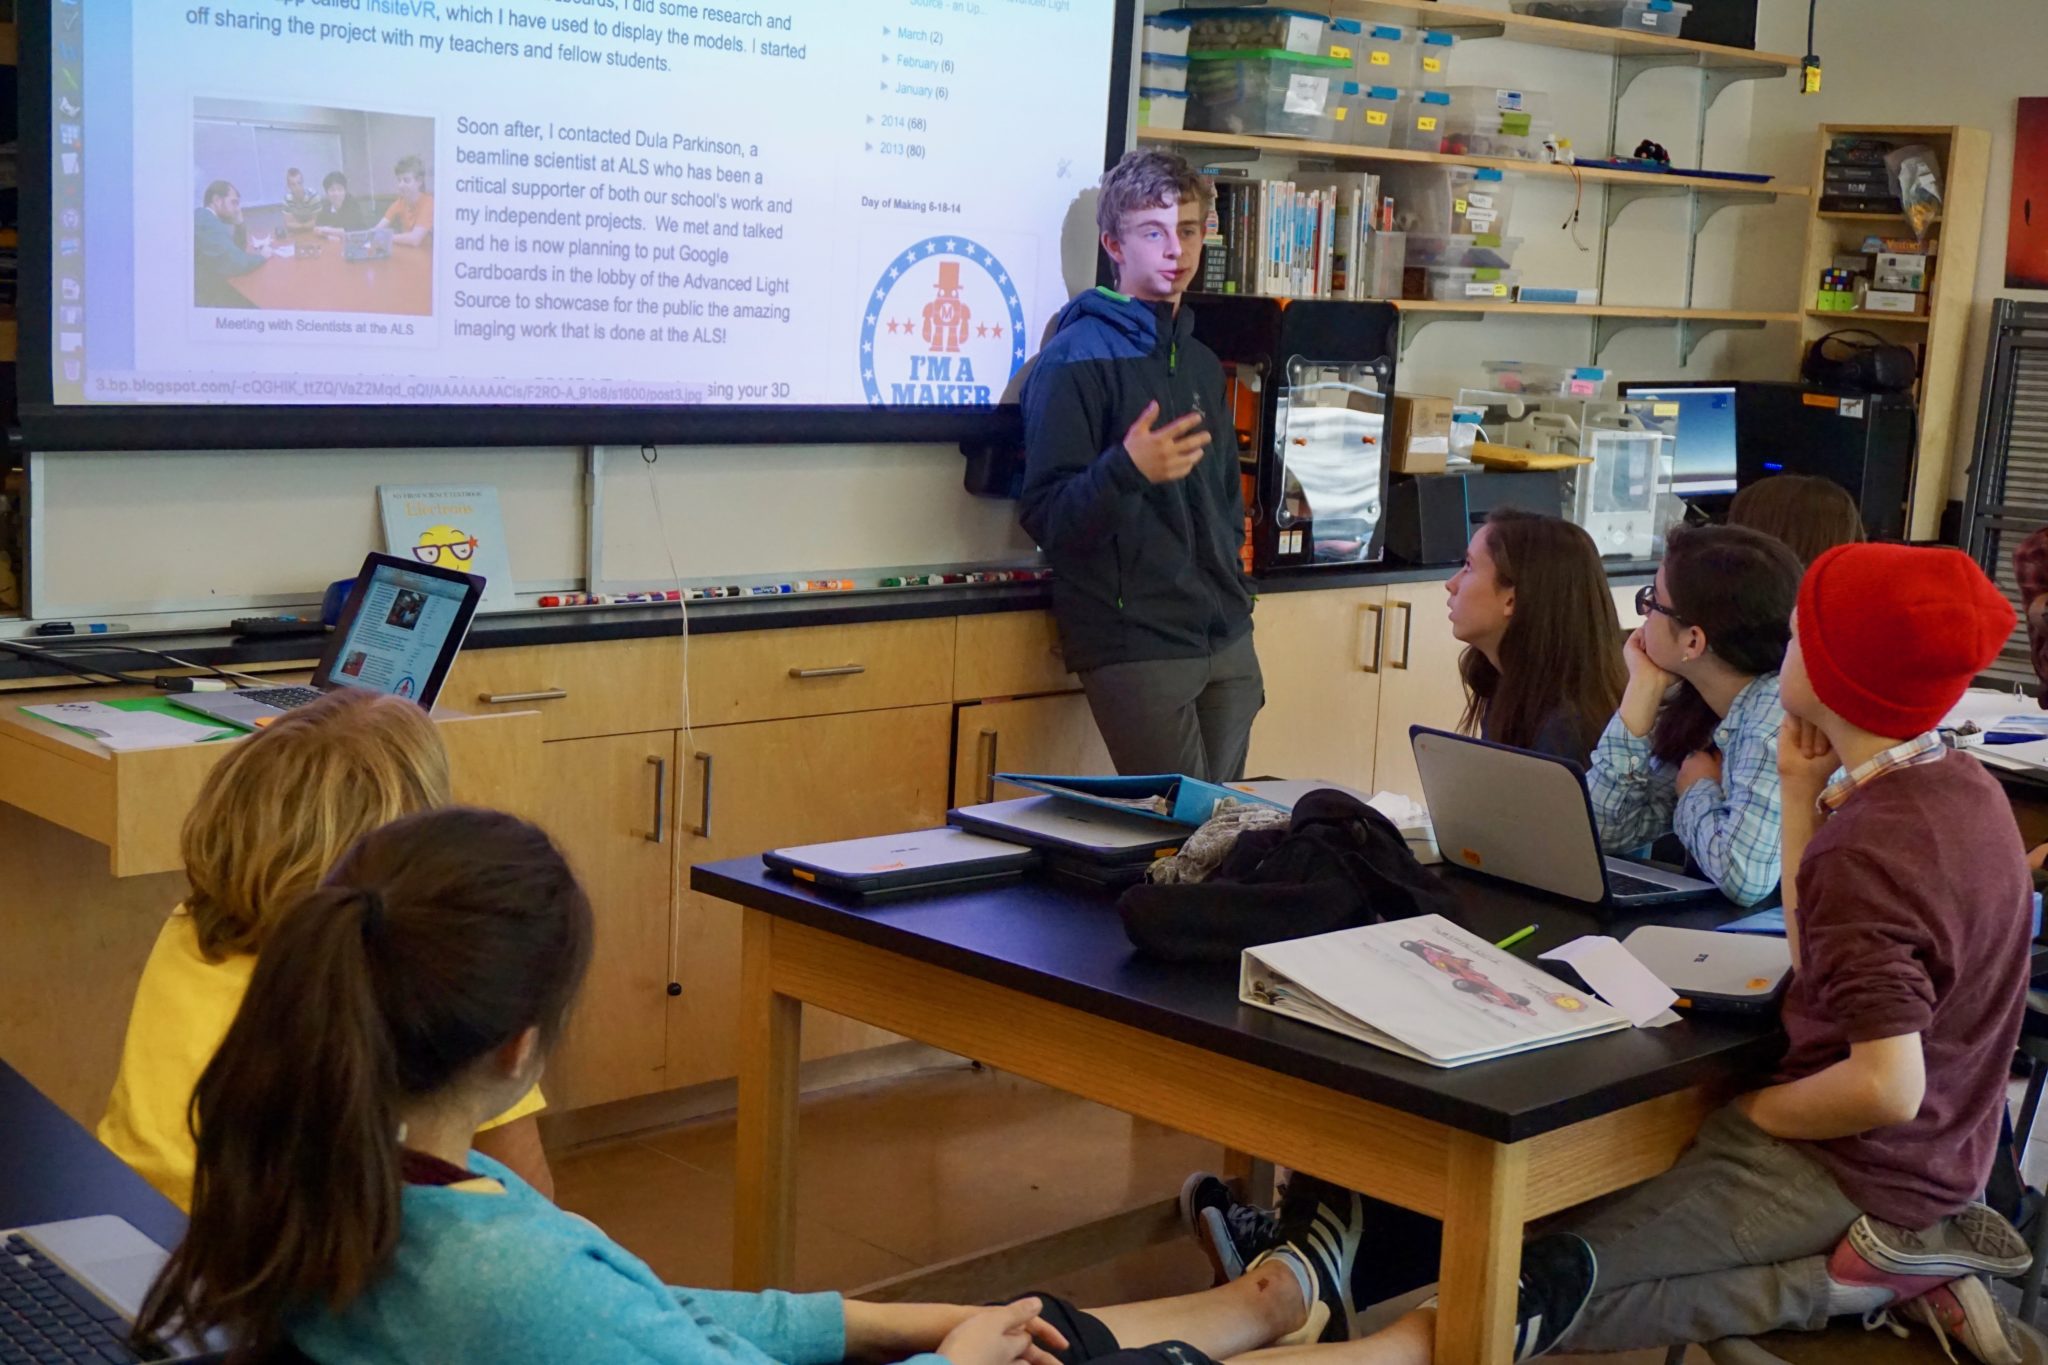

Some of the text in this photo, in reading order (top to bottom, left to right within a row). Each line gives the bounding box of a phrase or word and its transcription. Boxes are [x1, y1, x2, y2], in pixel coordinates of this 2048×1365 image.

[633, 0, 654, 13] did
[659, 2, 698, 18] some
[703, 8, 762, 27] research
[766, 15, 792, 31] and
[186, 6, 671, 71] off sharing the project with my teachers and fellow students.
[446, 5, 493, 24] which
[499, 8, 503, 25] I
[509, 9, 546, 29] have
[552, 17, 588, 34] used
[594, 19, 608, 36] to
[612, 21, 663, 46] display
[667, 28, 689, 46] the
[694, 34, 747, 52] models.
[752, 38, 756, 53] I
[760, 41, 806, 60] started
[898, 26, 943, 46] March (2)
[897, 54, 939, 72] February
[895, 82, 933, 99] January
[457, 116, 758, 158] Soon after, I contacted Dula Parkinson, a
[881, 114, 927, 132] 2014 (68)
[880, 141, 904, 155] 2013
[456, 146, 763, 185] beamline scientist at ALS who has been a
[456, 176, 792, 214] critical supporter of both our school's work and
[861, 196, 879, 210] Day
[882, 198, 892, 208] of
[893, 198, 926, 213] Making
[455, 206, 783, 239] my independent projects. We met and talked
[455, 234, 729, 267] and he is now planning to put Google
[454, 262, 789, 296] Cardboards in the lobby of the Advanced Light
[454, 290, 790, 323] Source to showcase for the public the amazing
[216, 317, 414, 335] Meeting with Scientists at the ALS
[454, 319, 726, 344] imaging work that is done at the ALS!
[956, 357, 975, 383] A
[708, 381, 790, 401] sing your 3D
